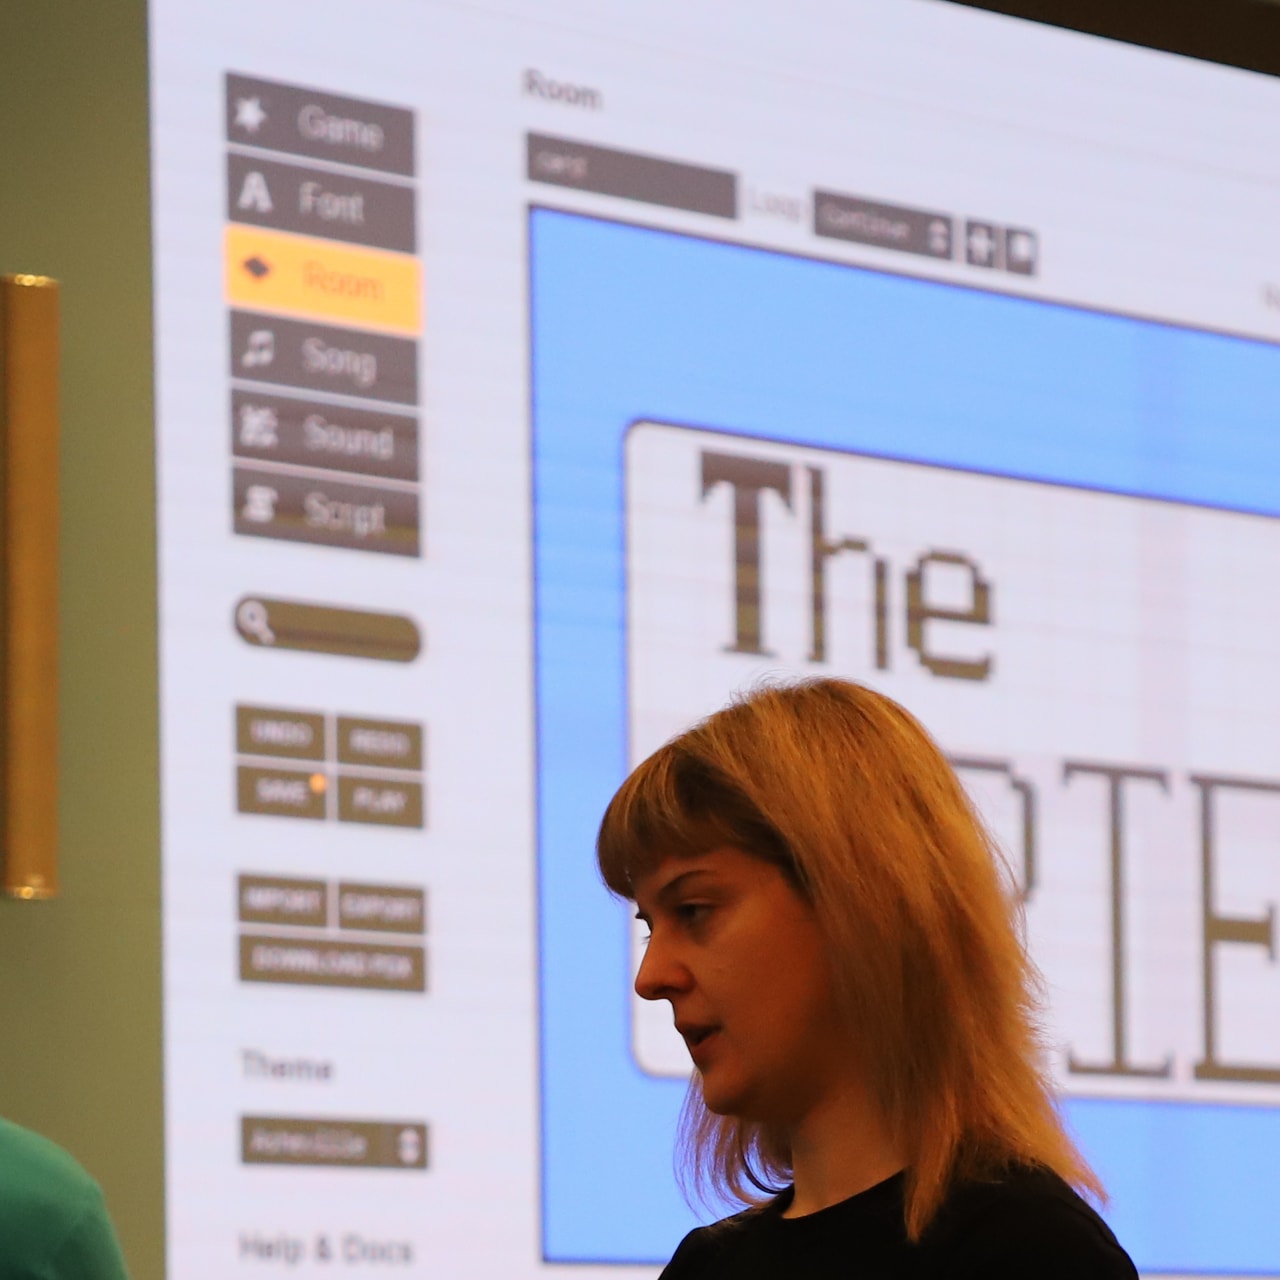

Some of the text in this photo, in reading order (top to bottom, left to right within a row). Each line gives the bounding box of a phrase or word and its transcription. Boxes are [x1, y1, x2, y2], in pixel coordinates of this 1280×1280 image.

[523, 69, 602, 110] Room
[298, 104, 385, 152] Game
[299, 181, 365, 225] Font
[303, 260, 385, 302] Room
[302, 336, 377, 386] Song
[303, 414, 395, 461] Sound
[304, 491, 387, 538] Script
[698, 448, 996, 683] The
[240, 1049, 333, 1083] Theme
[239, 1232, 303, 1268] Help
[343, 1235, 415, 1264] Docs
